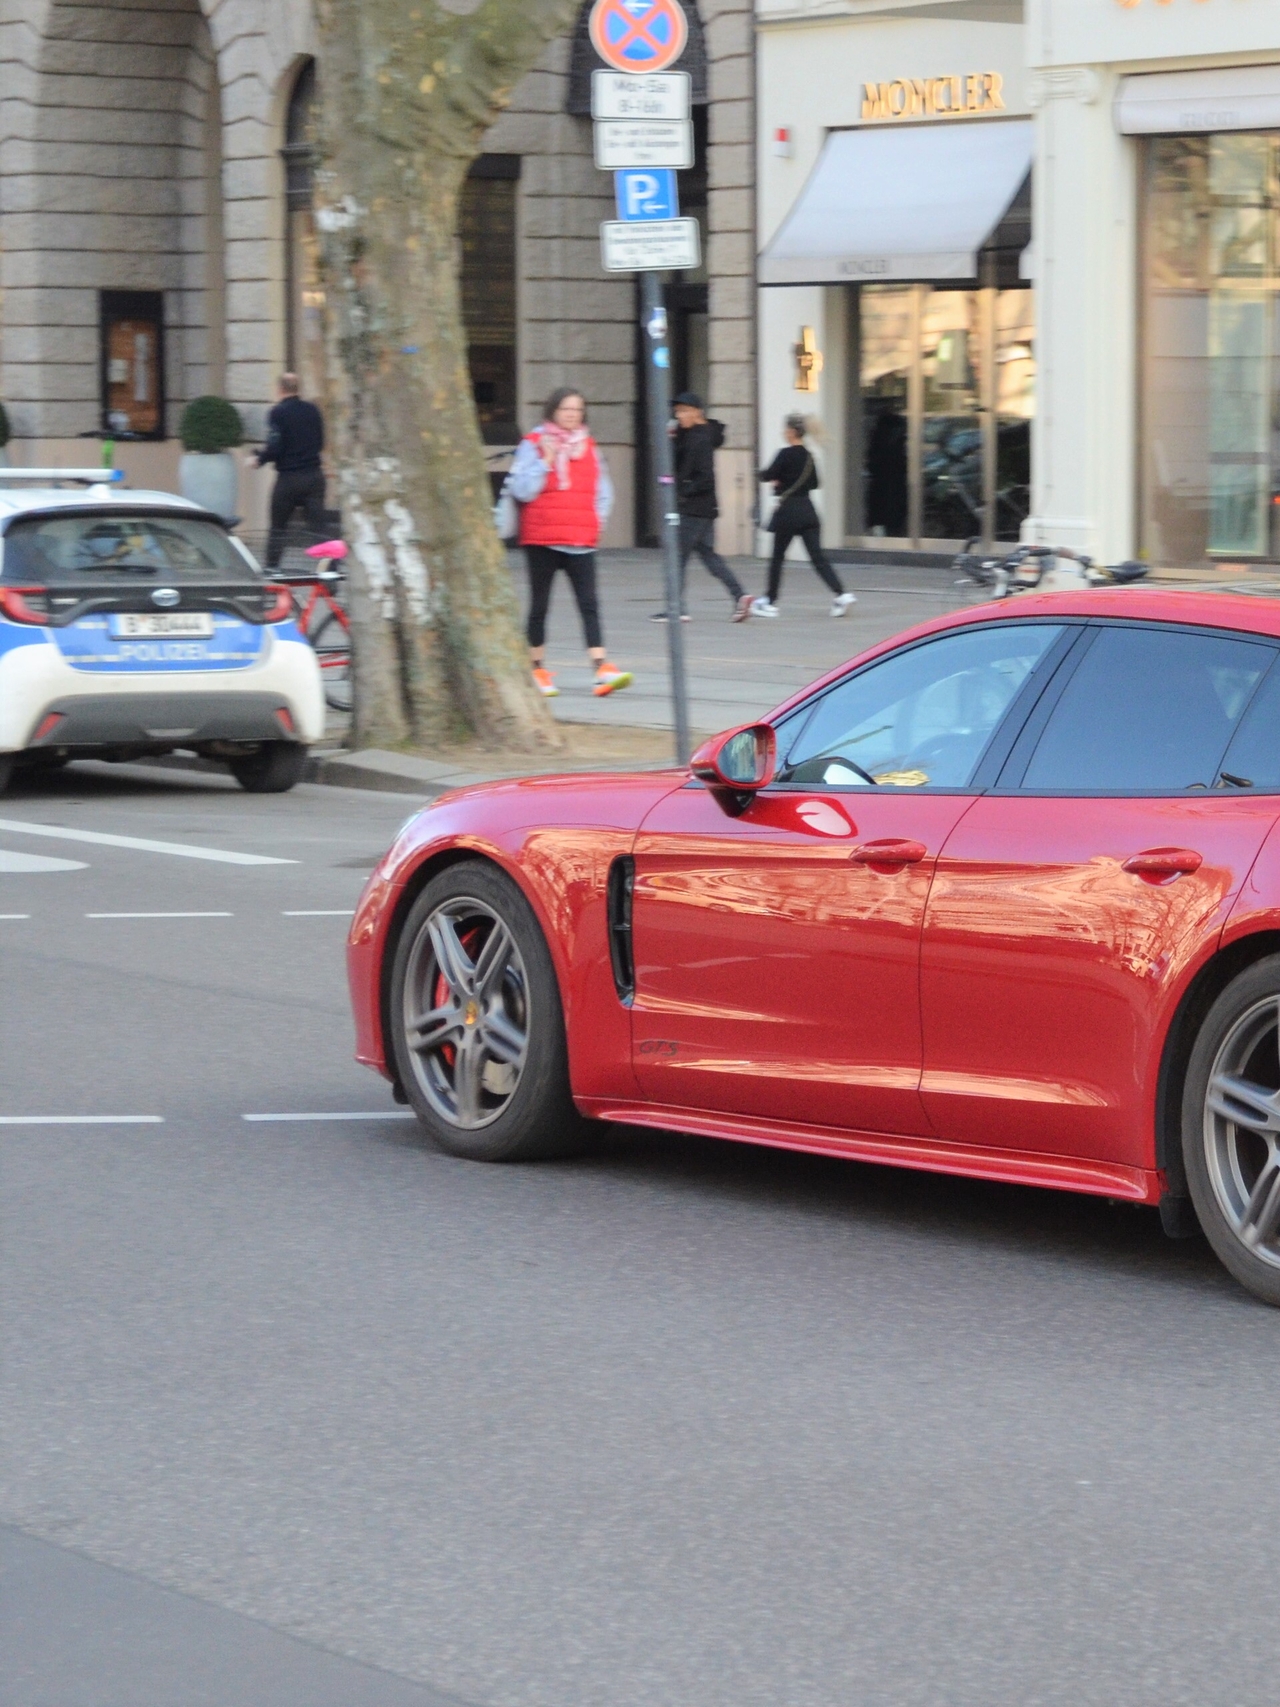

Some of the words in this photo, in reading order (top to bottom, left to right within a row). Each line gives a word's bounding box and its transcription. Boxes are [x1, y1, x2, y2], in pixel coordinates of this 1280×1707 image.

[860, 71, 1006, 119] MONCLER
[625, 173, 660, 215] P
[118, 644, 207, 661] POLIZEI
